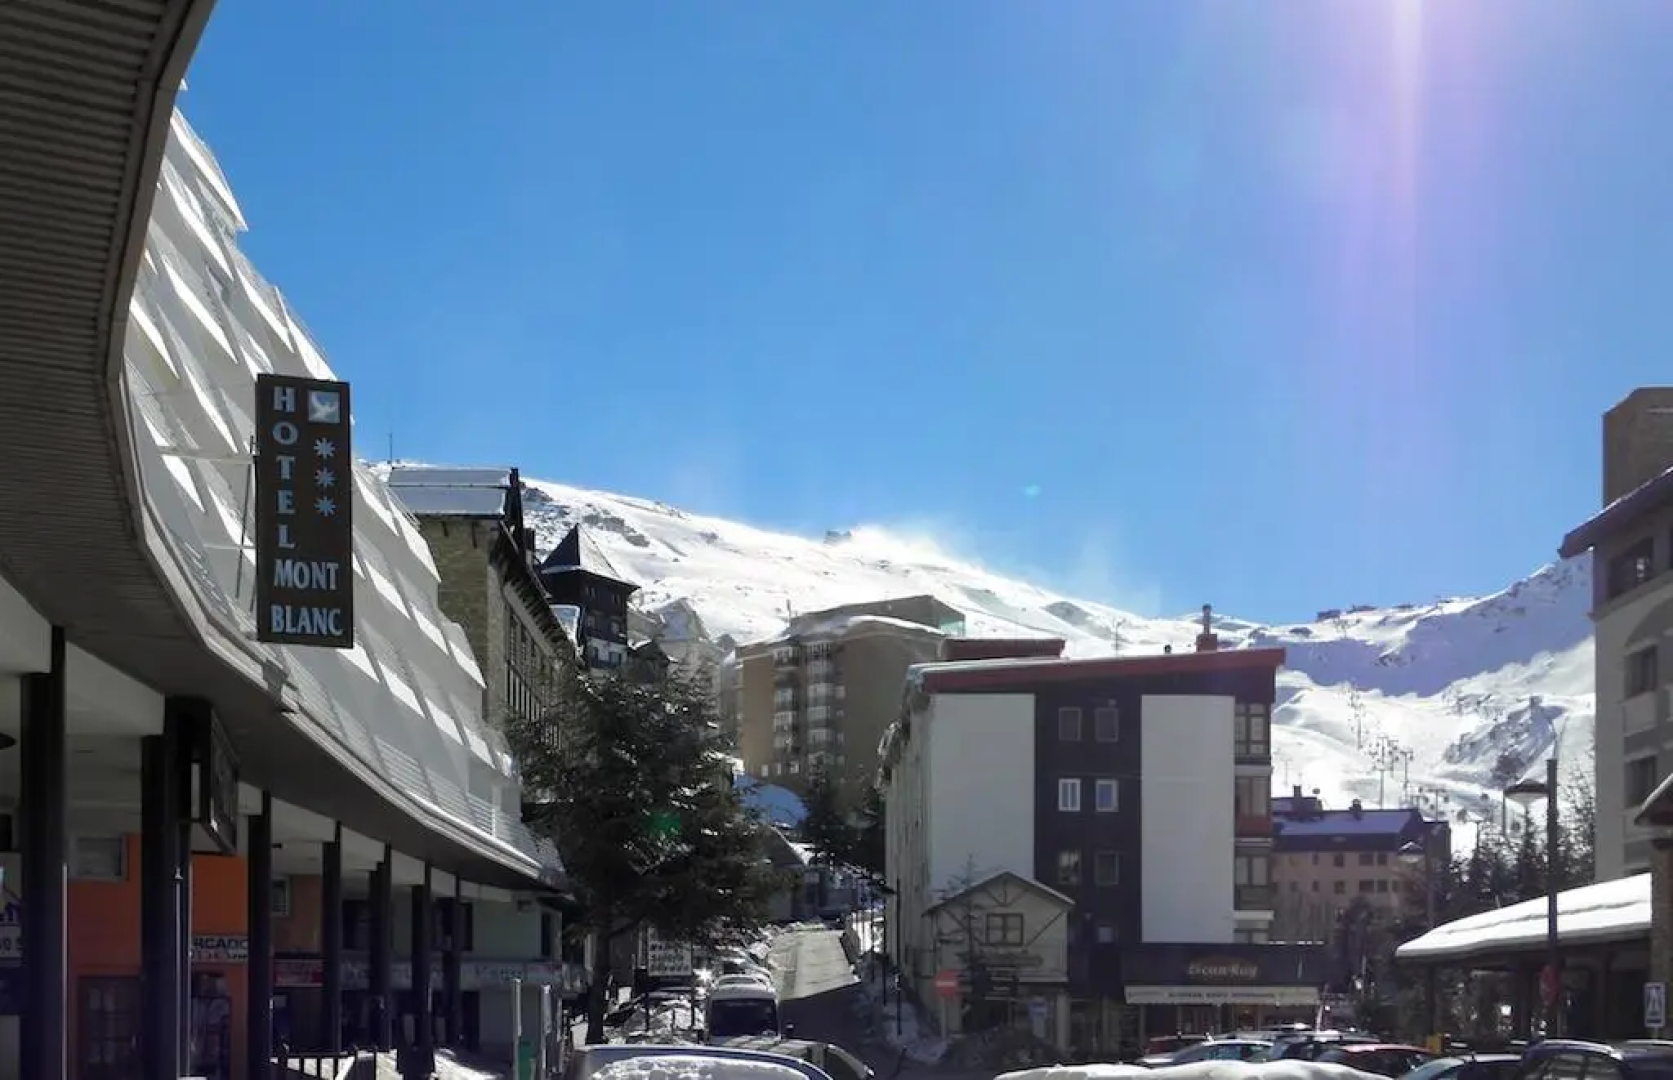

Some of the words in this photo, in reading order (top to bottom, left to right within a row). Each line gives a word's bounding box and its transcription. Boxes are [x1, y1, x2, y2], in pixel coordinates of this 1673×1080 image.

[272, 386, 299, 549] HOTEL
[274, 558, 340, 591] MONT
[270, 604, 344, 636] BLANC
